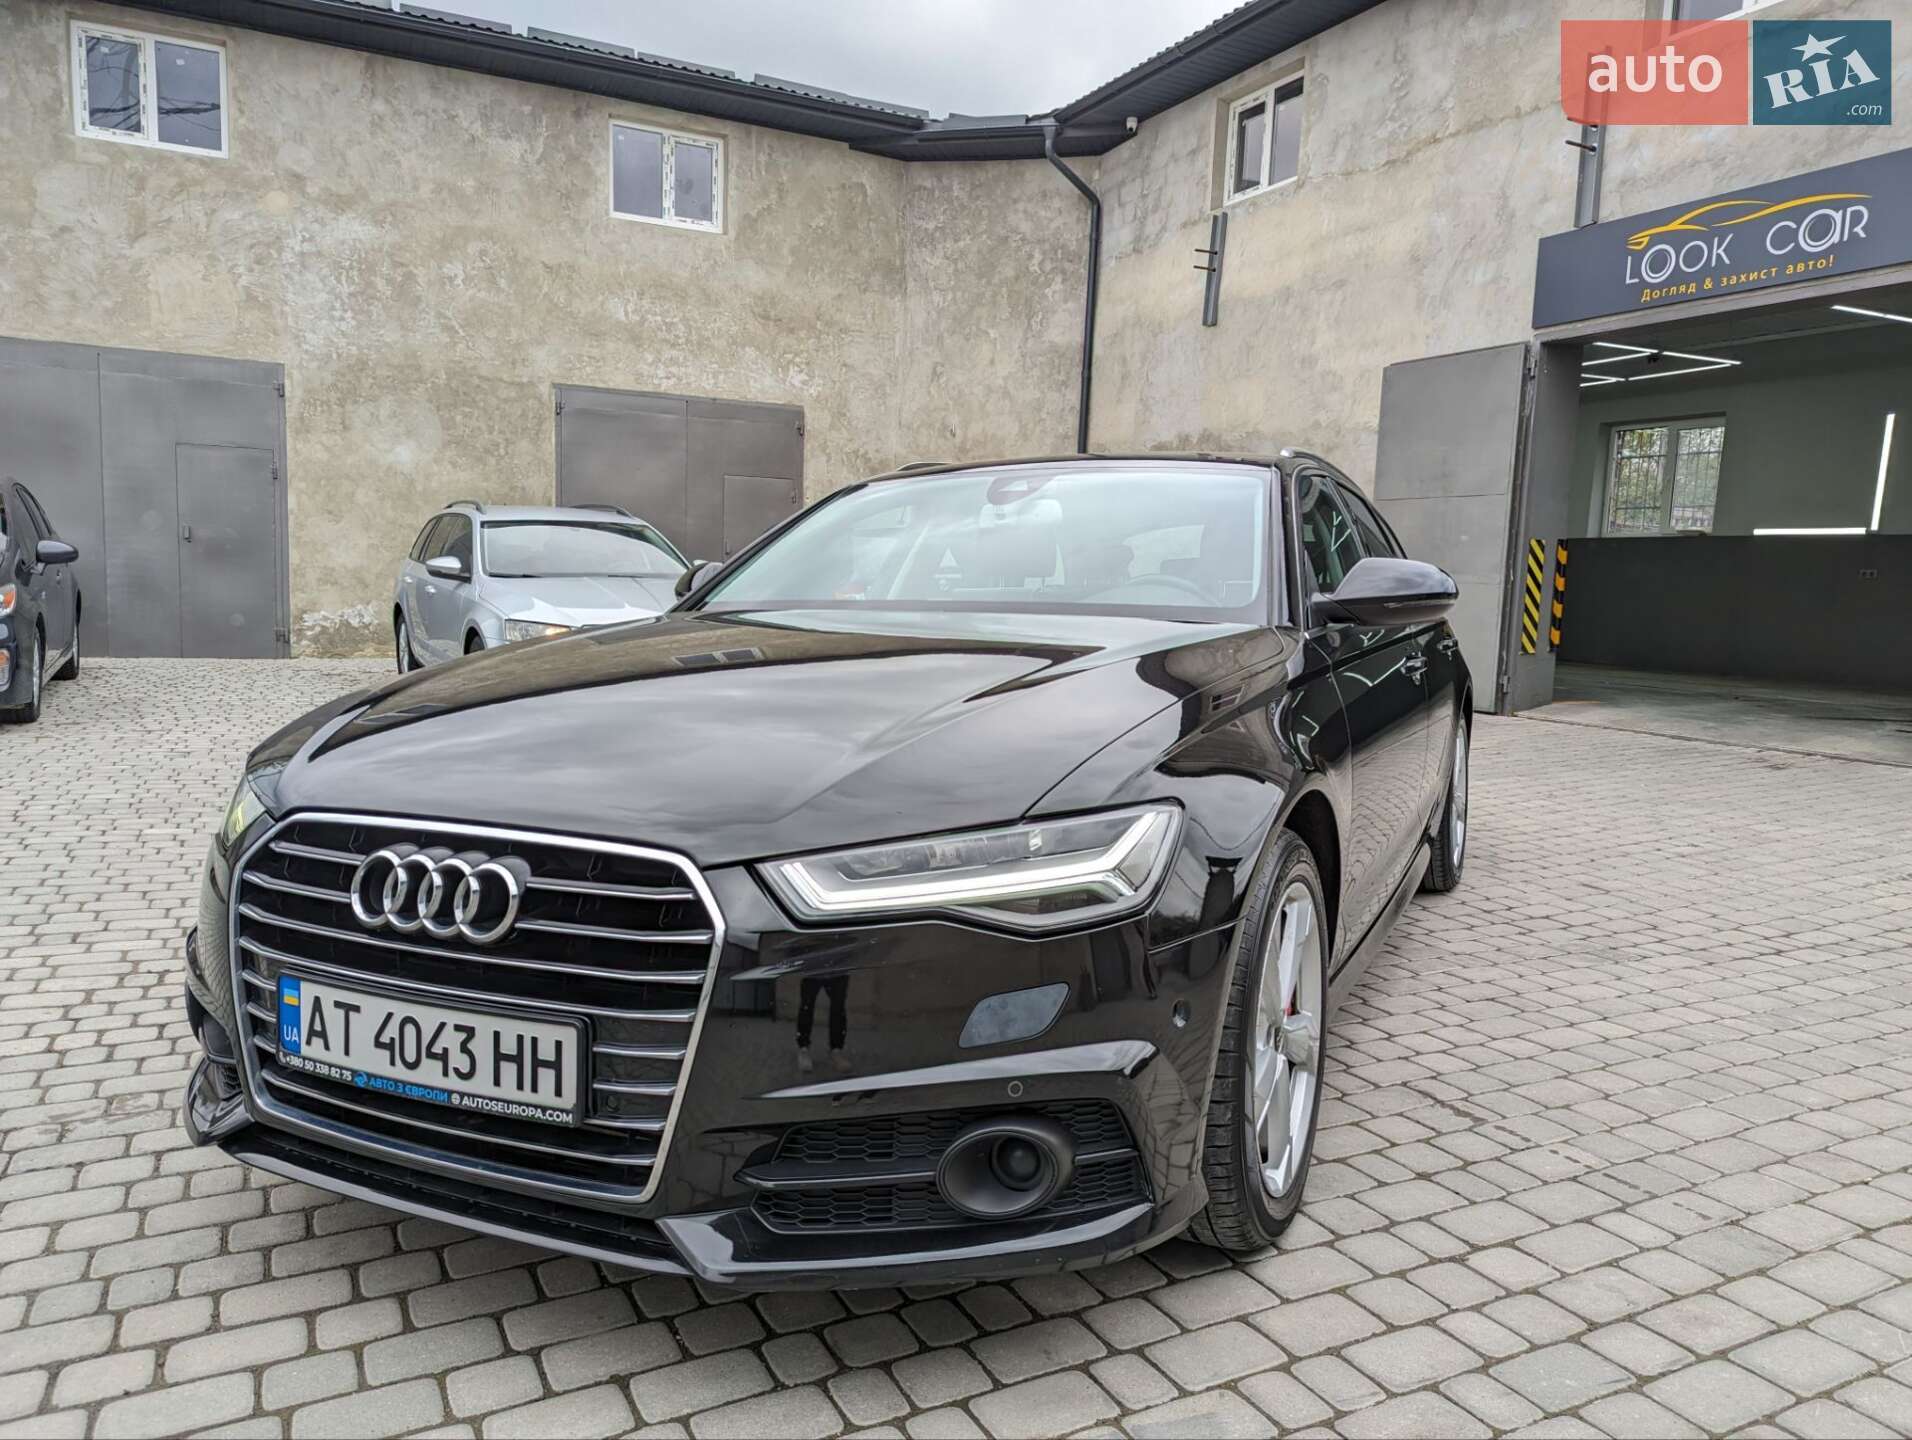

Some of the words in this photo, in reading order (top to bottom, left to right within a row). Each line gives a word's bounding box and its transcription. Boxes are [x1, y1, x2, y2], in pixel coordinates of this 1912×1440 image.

[1625, 233, 1734, 285] LOOK
[1641, 282, 1697, 303] Догляд
[1703, 277, 1714, 290] &
[1720, 265, 1778, 287] захист
[1786, 254, 1836, 275] авто!
[283, 1025, 300, 1042] UA
[305, 996, 361, 1056] AT
[373, 1011, 476, 1080] 4043
[492, 1029, 563, 1098] HH
[304, 1060, 314, 1071] 50
[315, 1063, 329, 1075] 338
[330, 1067, 340, 1078] 82
[341, 1070, 352, 1081] 75
[368, 1078, 396, 1091] АВТО
[461, 1096, 573, 1124] AUTOSEUROPA.COM
